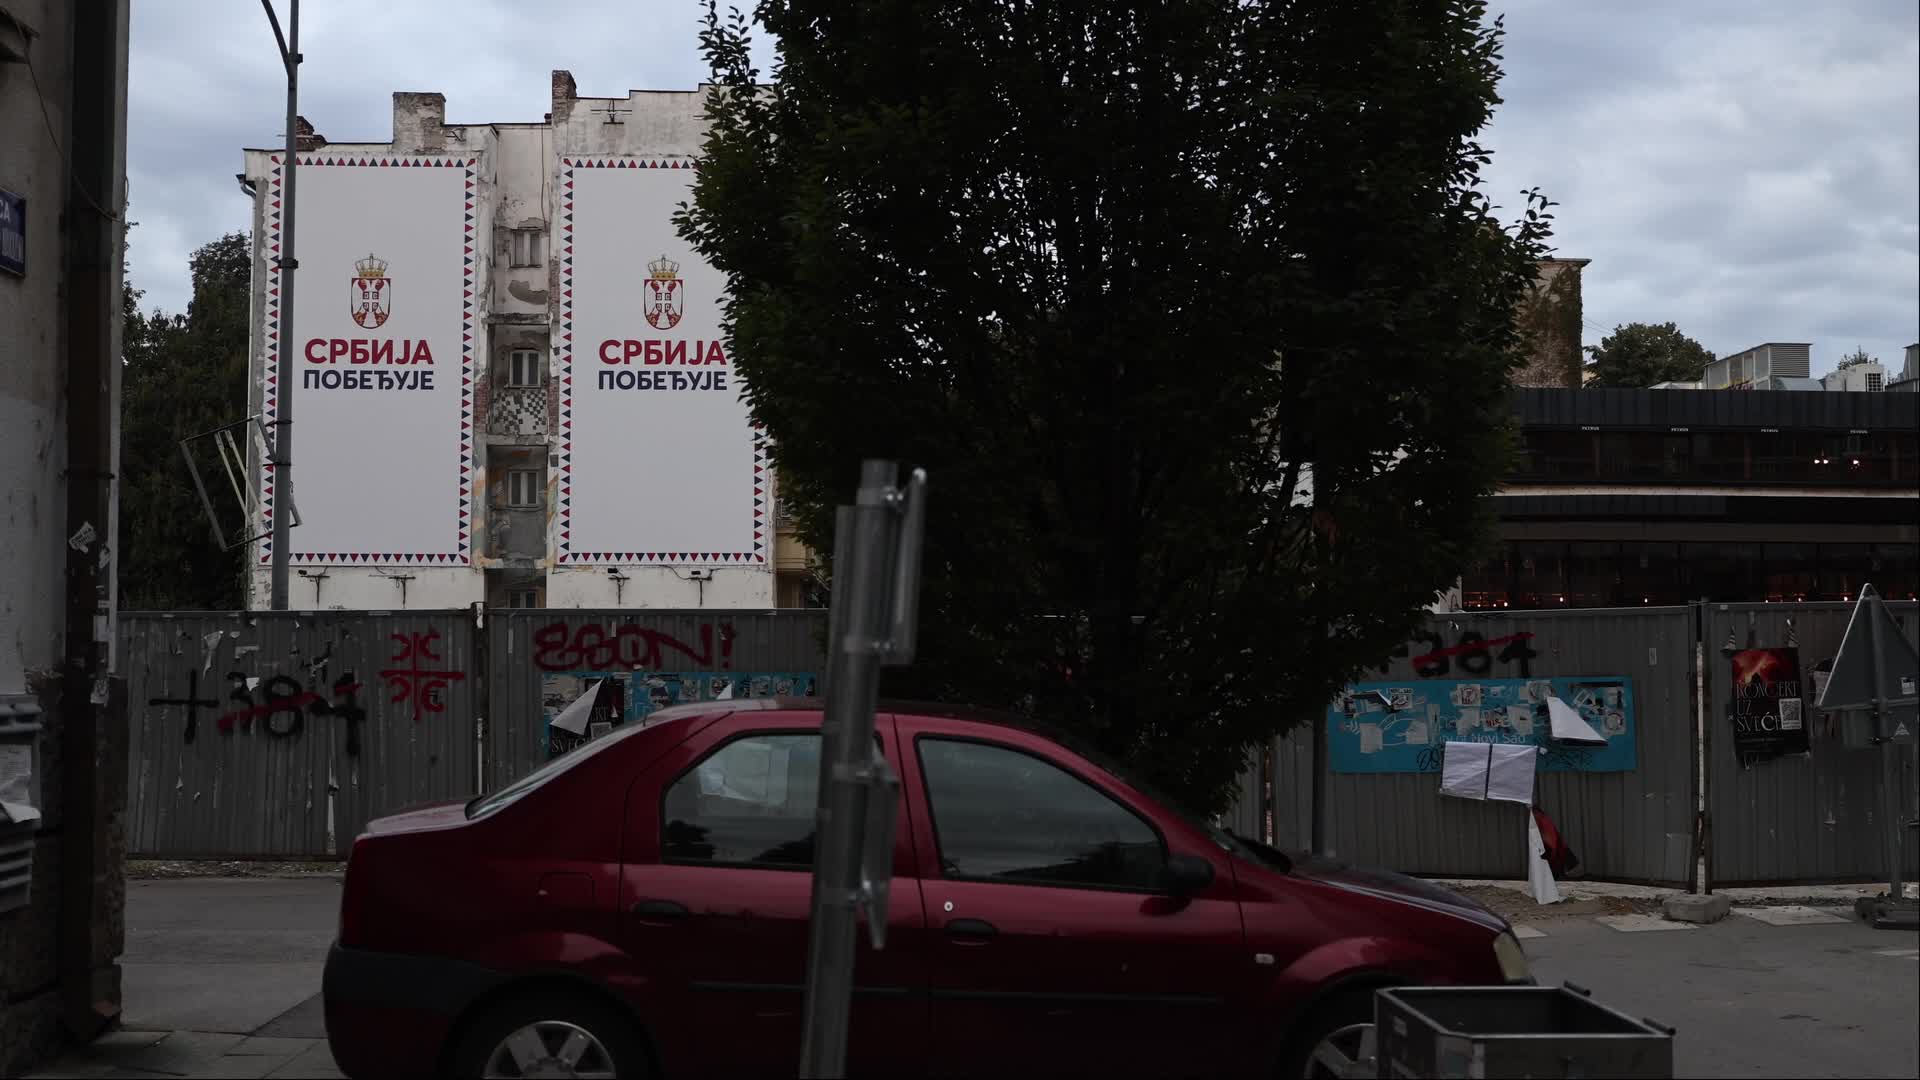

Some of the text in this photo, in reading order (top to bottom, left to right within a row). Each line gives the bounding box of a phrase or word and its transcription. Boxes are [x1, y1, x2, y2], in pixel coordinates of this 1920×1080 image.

[304, 338, 434, 365] СРБИЈА
[599, 339, 727, 366] СРБИЈА
[304, 369, 434, 390] ПОБЕЂУЈЕ
[599, 370, 727, 391] ПОБЕЂУЈЕ
